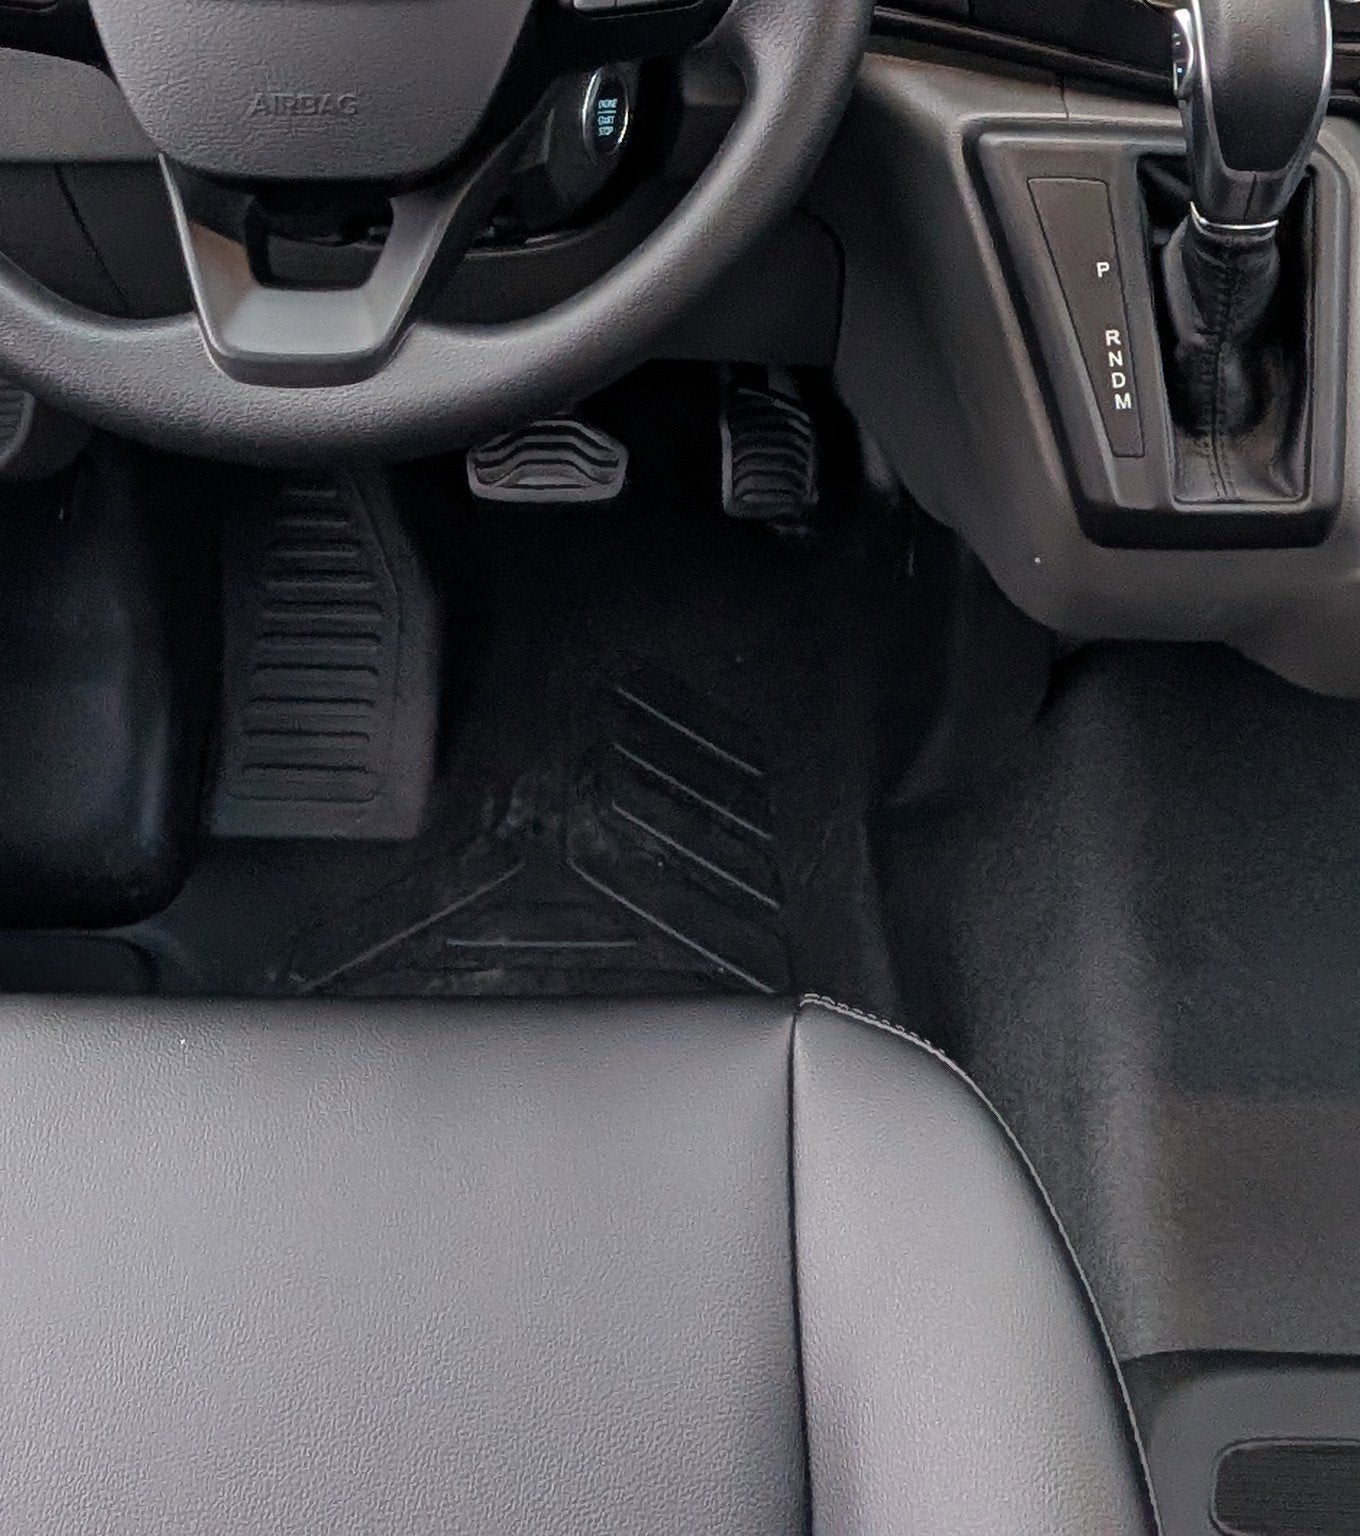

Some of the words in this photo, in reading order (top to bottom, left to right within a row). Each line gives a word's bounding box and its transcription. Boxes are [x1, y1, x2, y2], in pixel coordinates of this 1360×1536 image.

[246, 91, 360, 118] AIRBAG
[1096, 261, 1111, 278] P
[1105, 329, 1121, 347] R
[1108, 350, 1124, 368] N
[1111, 371, 1127, 389] D
[1114, 392, 1132, 410] M
